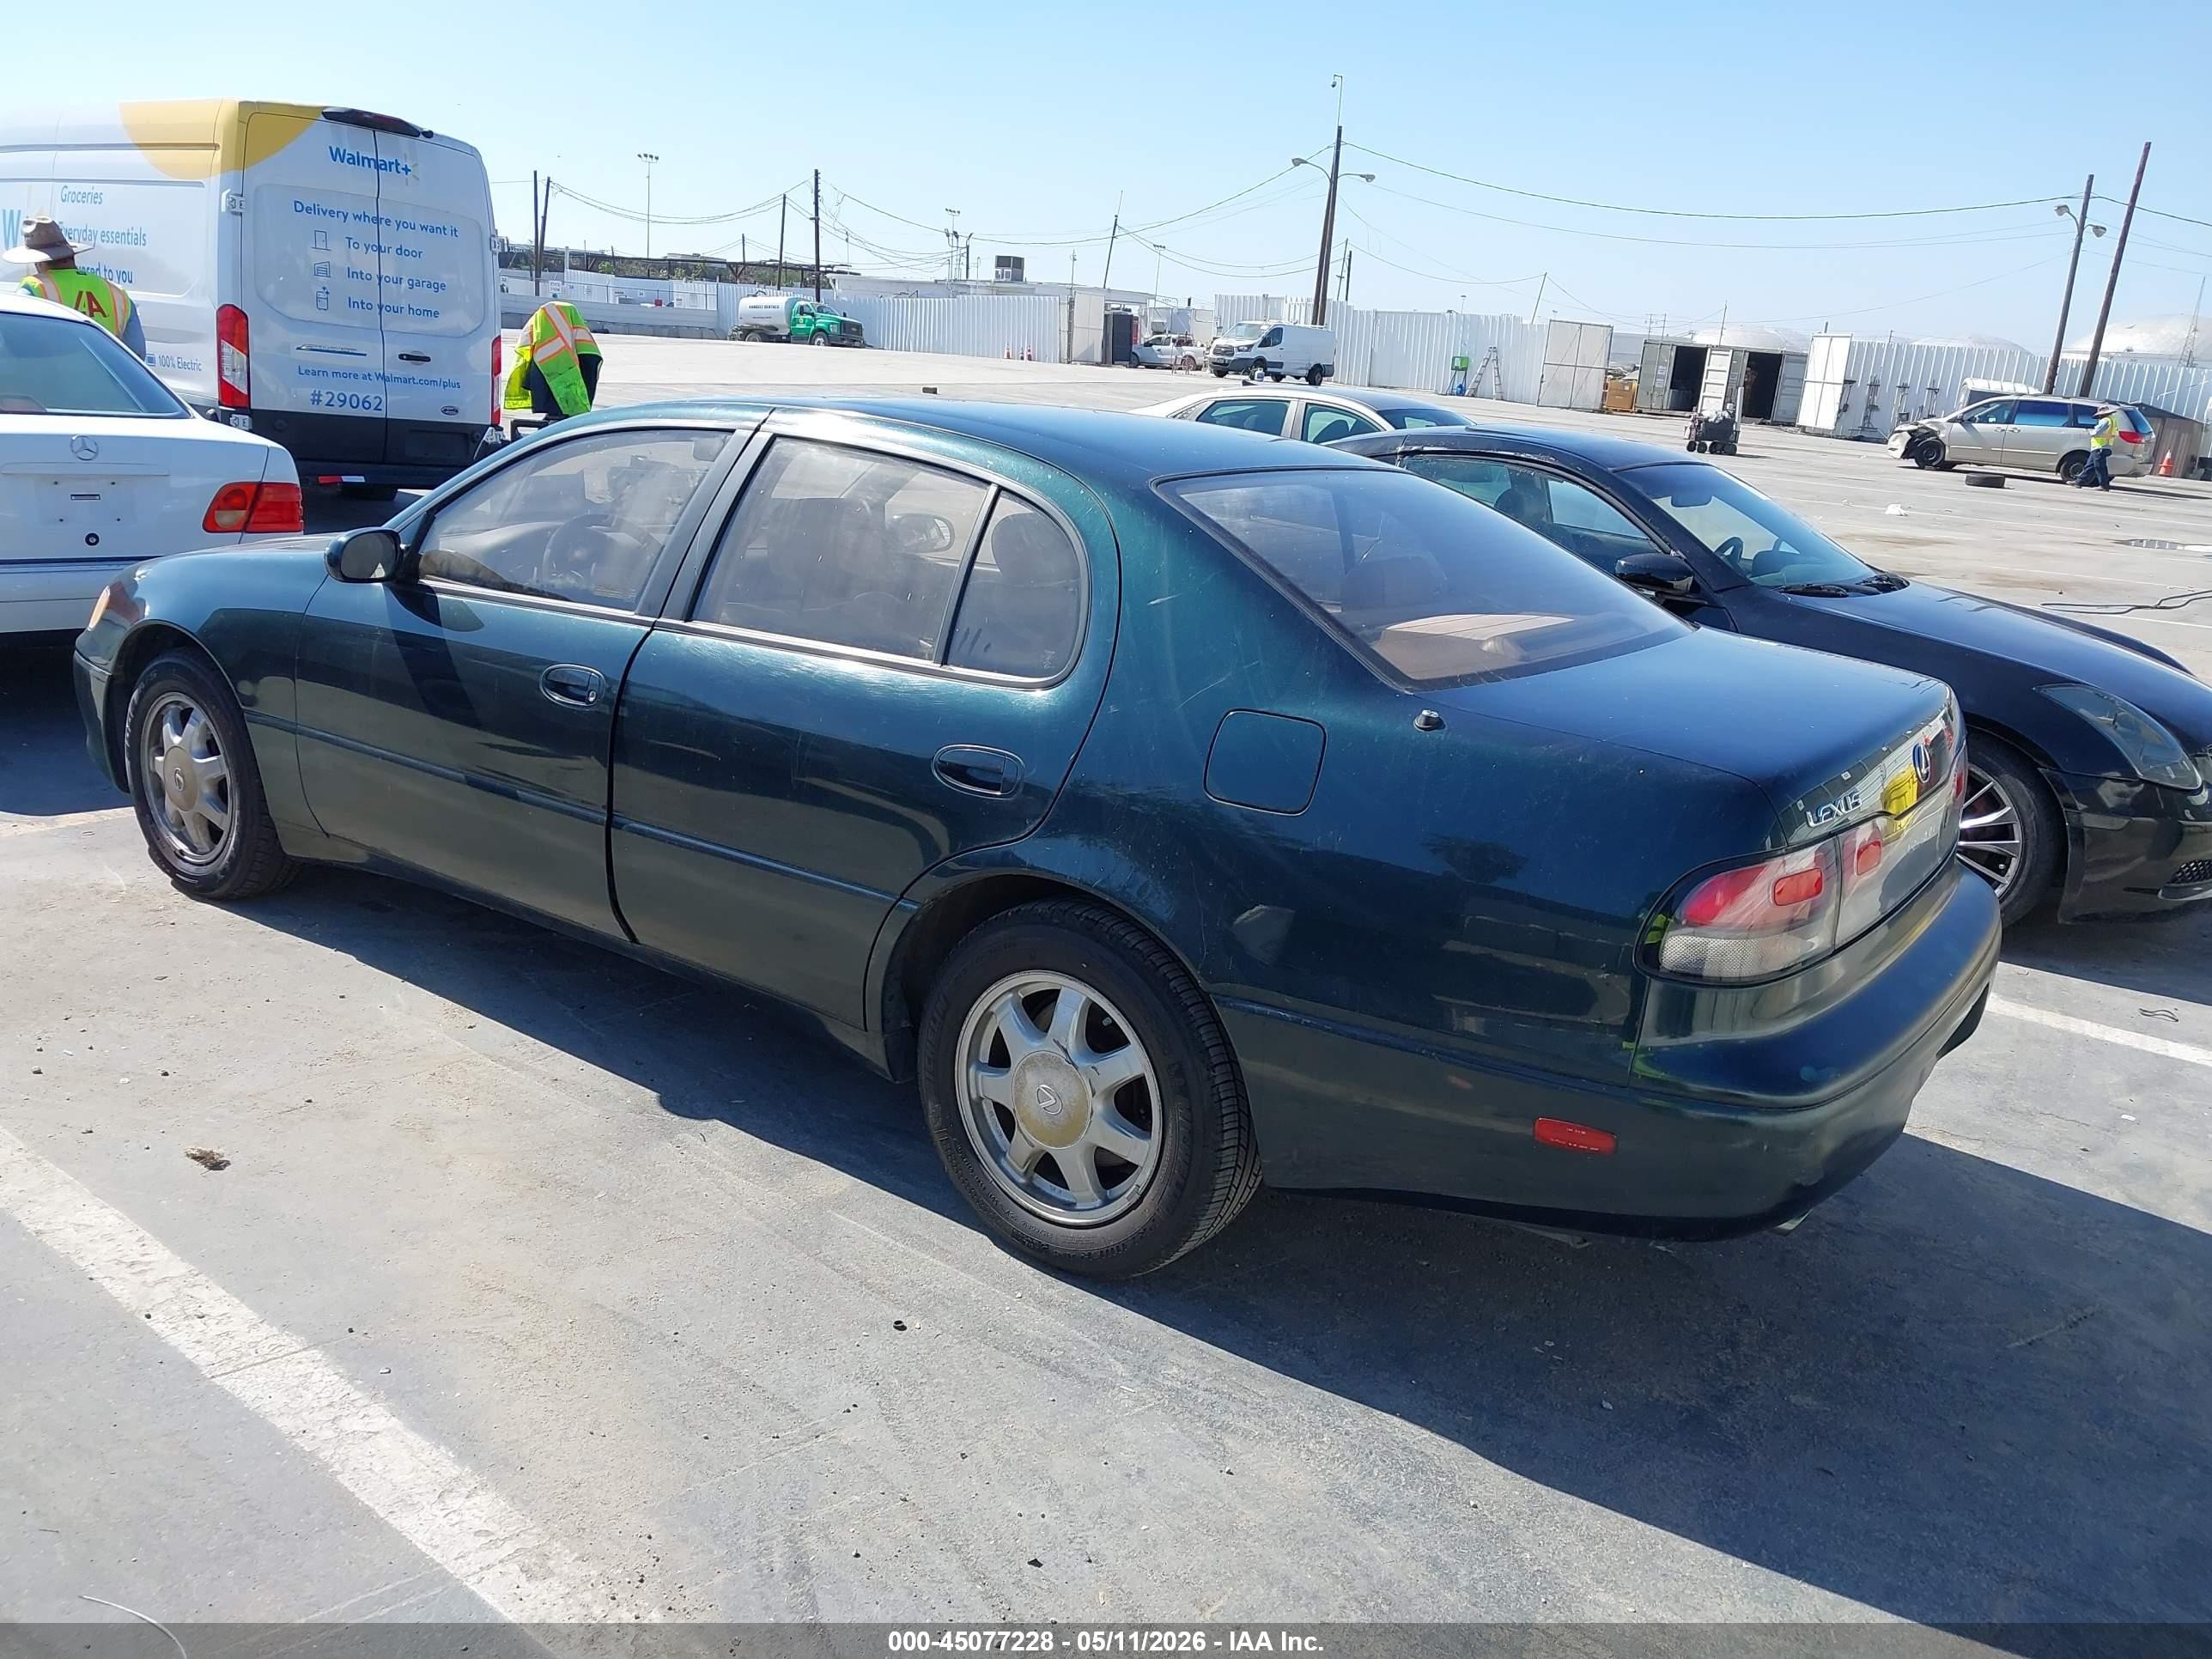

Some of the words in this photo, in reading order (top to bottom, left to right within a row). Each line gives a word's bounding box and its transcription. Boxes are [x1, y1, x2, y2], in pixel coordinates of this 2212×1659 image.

[328, 145, 412, 176] Walmart+
[60, 185, 104, 206] Groceries
[294, 200, 349, 223] Delivery
[352, 211, 392, 227] where
[395, 218, 416, 232] you
[419, 223, 447, 236] want
[450, 226, 459, 238] it
[100, 226, 147, 246] essentials
[345, 237, 360, 250] To
[363, 242, 392, 255] your
[395, 245, 423, 259] door
[104, 264, 113, 281] to
[116, 270, 133, 284] you
[347, 268, 372, 282] Into
[376, 273, 403, 287] your
[407, 277, 447, 292] garage
[348, 297, 374, 311] Into
[376, 302, 404, 316] your
[408, 302, 440, 319] home
[158, 355, 175, 369] 100%
[177, 356, 202, 372] Electric
[298, 365, 329, 378] Learn
[331, 369, 359, 381] more
[362, 371, 372, 381] at
[374, 372, 461, 390] Walmart.com/plus
[310, 390, 383, 411] #29062
[1805, 790, 1863, 828] LEXUS
